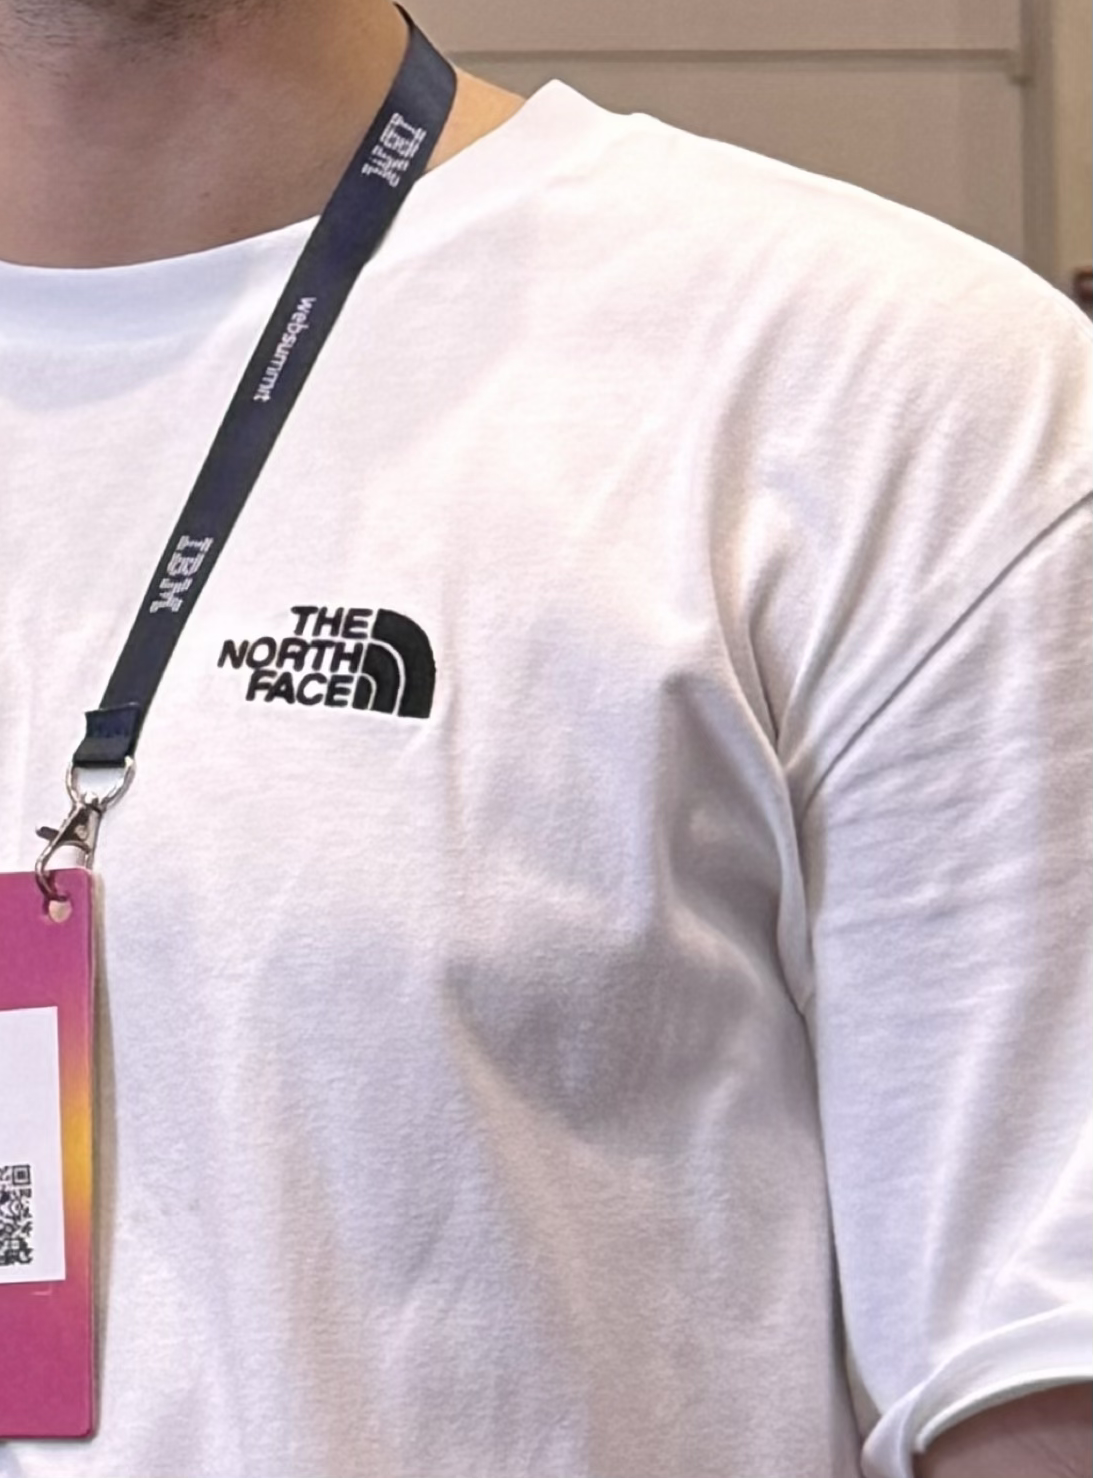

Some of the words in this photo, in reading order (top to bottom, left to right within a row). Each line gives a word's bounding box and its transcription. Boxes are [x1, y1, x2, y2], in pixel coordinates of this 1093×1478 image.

[360, 112, 427, 188] IBM
[149, 534, 214, 614] IBM
[290, 605, 373, 639] THE
[217, 636, 364, 673] NORTH
[245, 669, 354, 708] FACE
